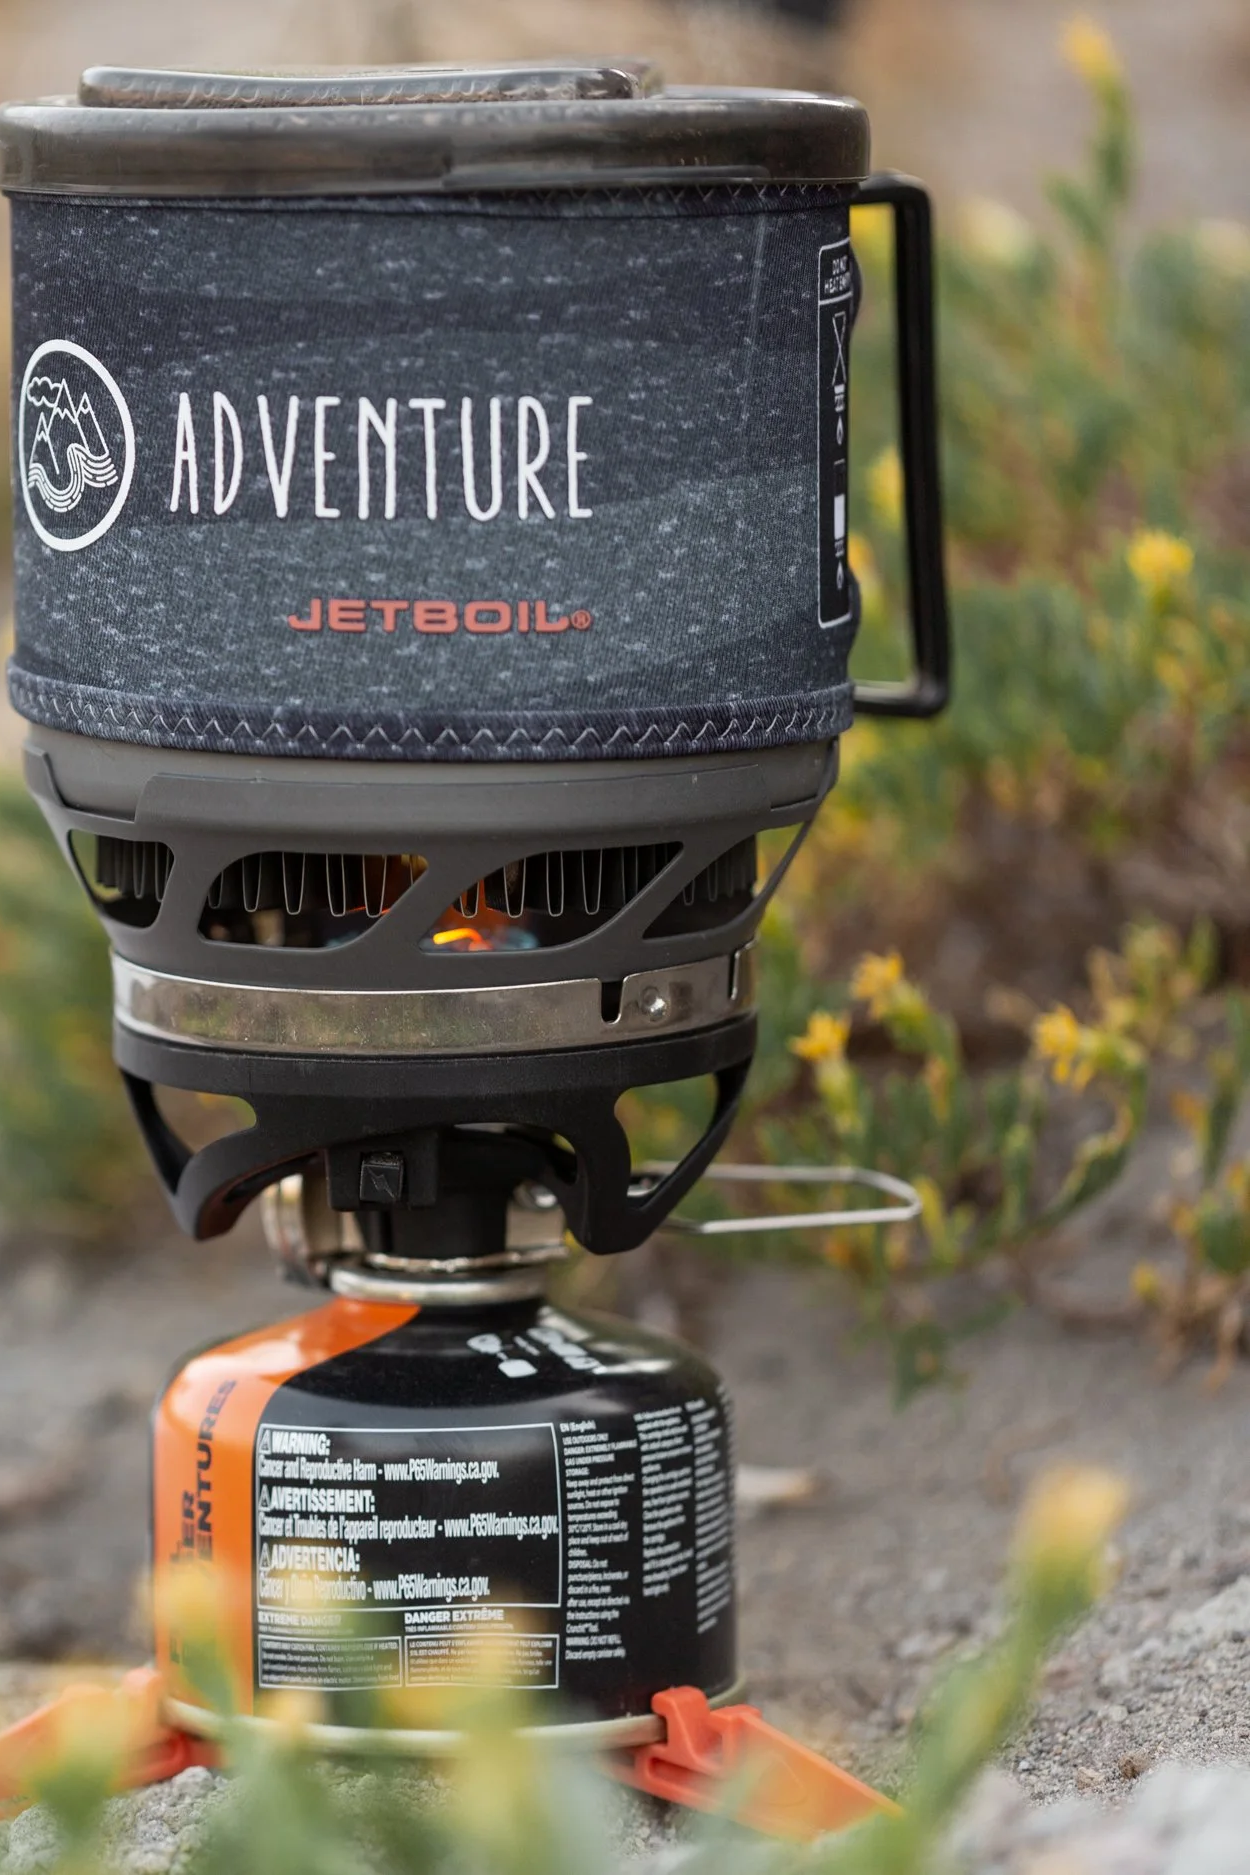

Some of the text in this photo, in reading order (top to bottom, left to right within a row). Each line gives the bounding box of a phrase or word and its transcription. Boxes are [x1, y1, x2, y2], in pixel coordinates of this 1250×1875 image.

[169, 391, 594, 521] ADVENTURE
[271, 1430, 330, 1456] WARNING:
[259, 1454, 284, 1478] Cancer
[284, 1456, 299, 1479] and
[300, 1456, 352, 1485] Reproductive
[353, 1458, 377, 1481] Harm
[384, 1457, 499, 1485] www.P65Warnings.ca.gov.
[270, 1485, 375, 1513] AVERTISSEMENT:
[259, 1511, 284, 1537] Cancer
[285, 1513, 294, 1537] et
[294, 1513, 327, 1539] Troubles
[327, 1514, 338, 1539] de
[380, 1515, 437, 1545] reproducteur
[444, 1511, 559, 1541] www.P65Warnings.ca.gov.
[270, 1544, 360, 1573] ADVERTENCIA:
[373, 1572, 490, 1603] www.P65Warnings.ca.gov.
[405, 1607, 504, 1625] DANGER EXTRÊME
